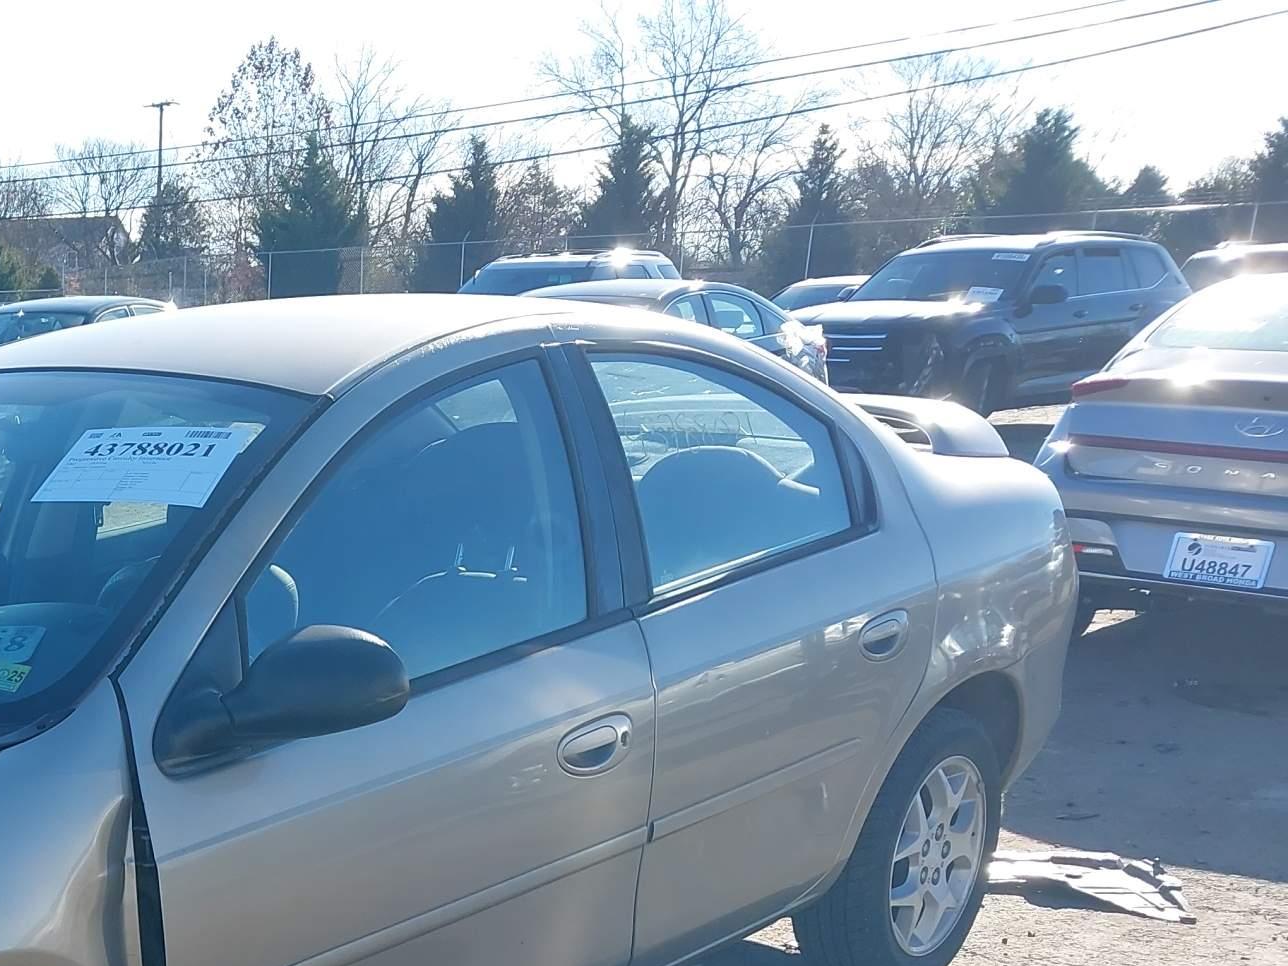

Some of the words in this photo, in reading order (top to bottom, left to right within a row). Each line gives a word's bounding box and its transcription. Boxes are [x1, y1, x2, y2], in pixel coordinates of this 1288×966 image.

[83, 441, 217, 457] 43788021
[1181, 557, 1253, 578] U48847
[1170, 571, 1194, 580] WEST
[1195, 574, 1225, 584] BROAD
[1226, 577, 1257, 587] HONDA
[6, 670, 26, 683] 25
